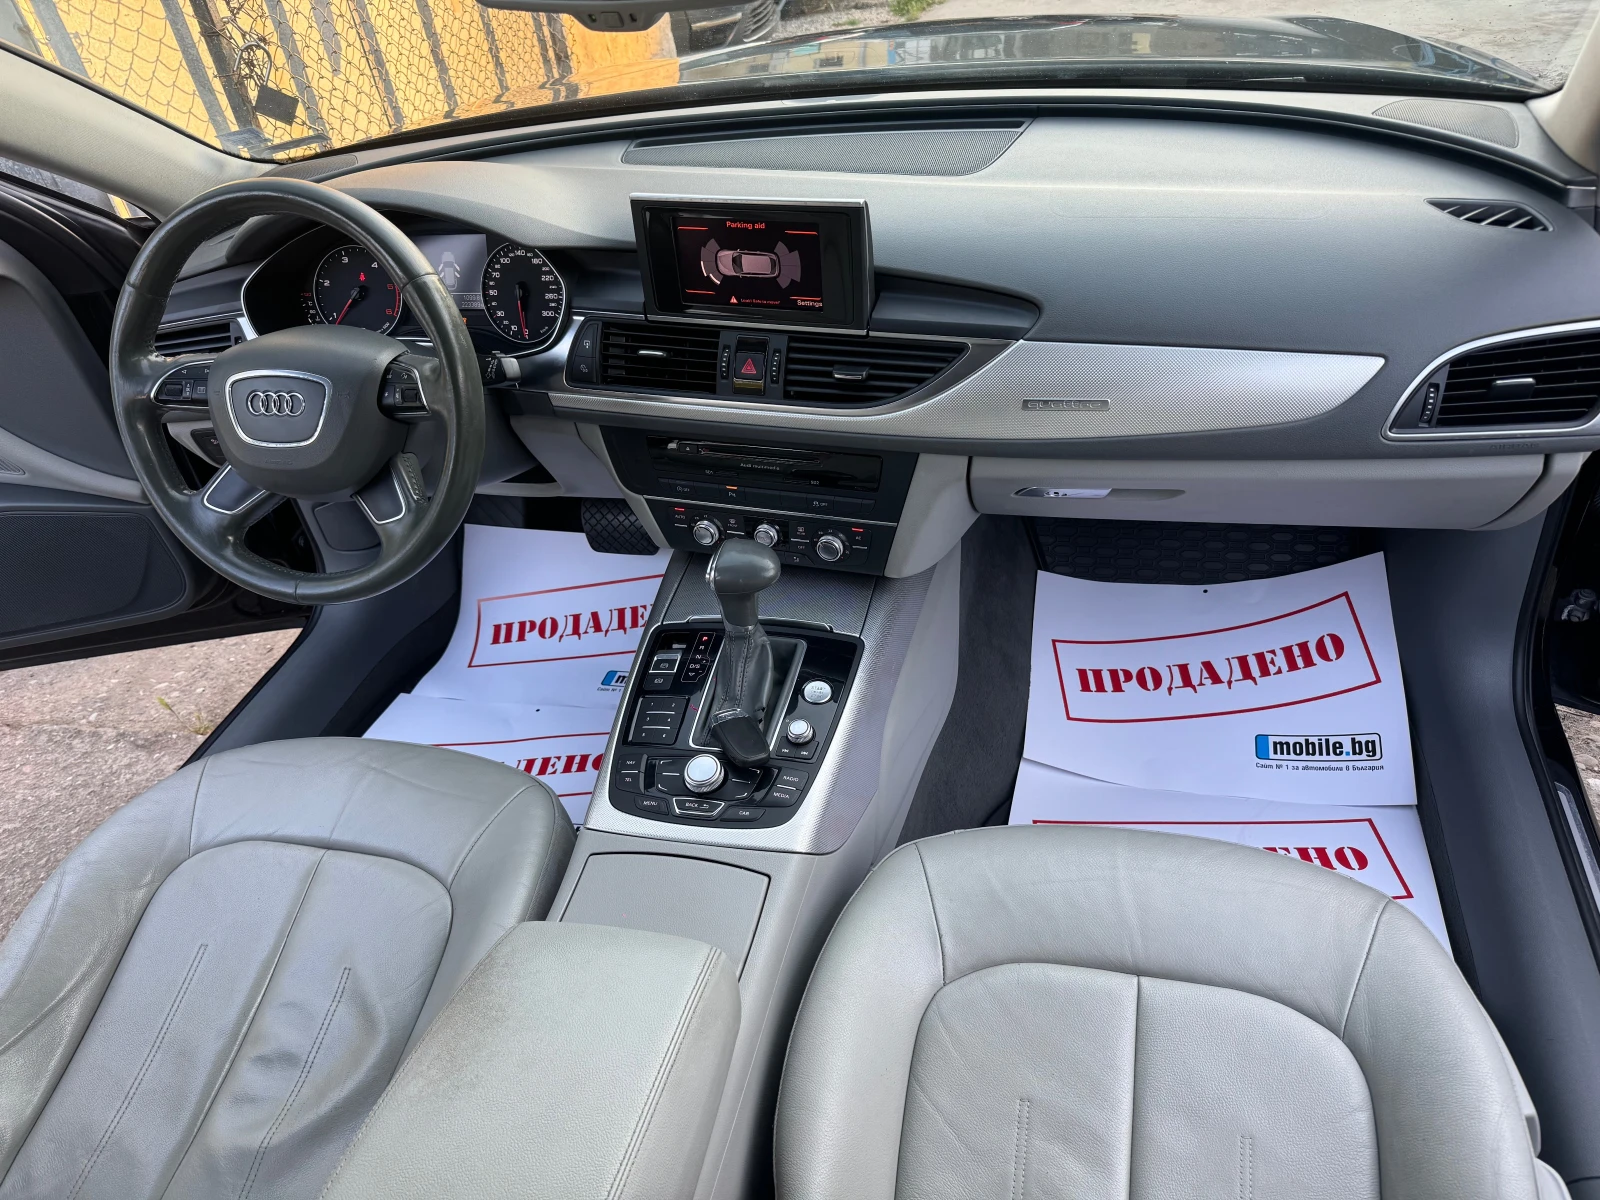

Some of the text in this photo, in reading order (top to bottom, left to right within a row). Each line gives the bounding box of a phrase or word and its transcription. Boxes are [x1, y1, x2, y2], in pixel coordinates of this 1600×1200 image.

[726, 220, 752, 230] Parking
[797, 300, 823, 308] Settings
[490, 603, 653, 646] ПРОДАДЕ
[1075, 632, 1345, 696] ПРОДАДЕНО
[1272, 736, 1377, 758] mobile.bg
